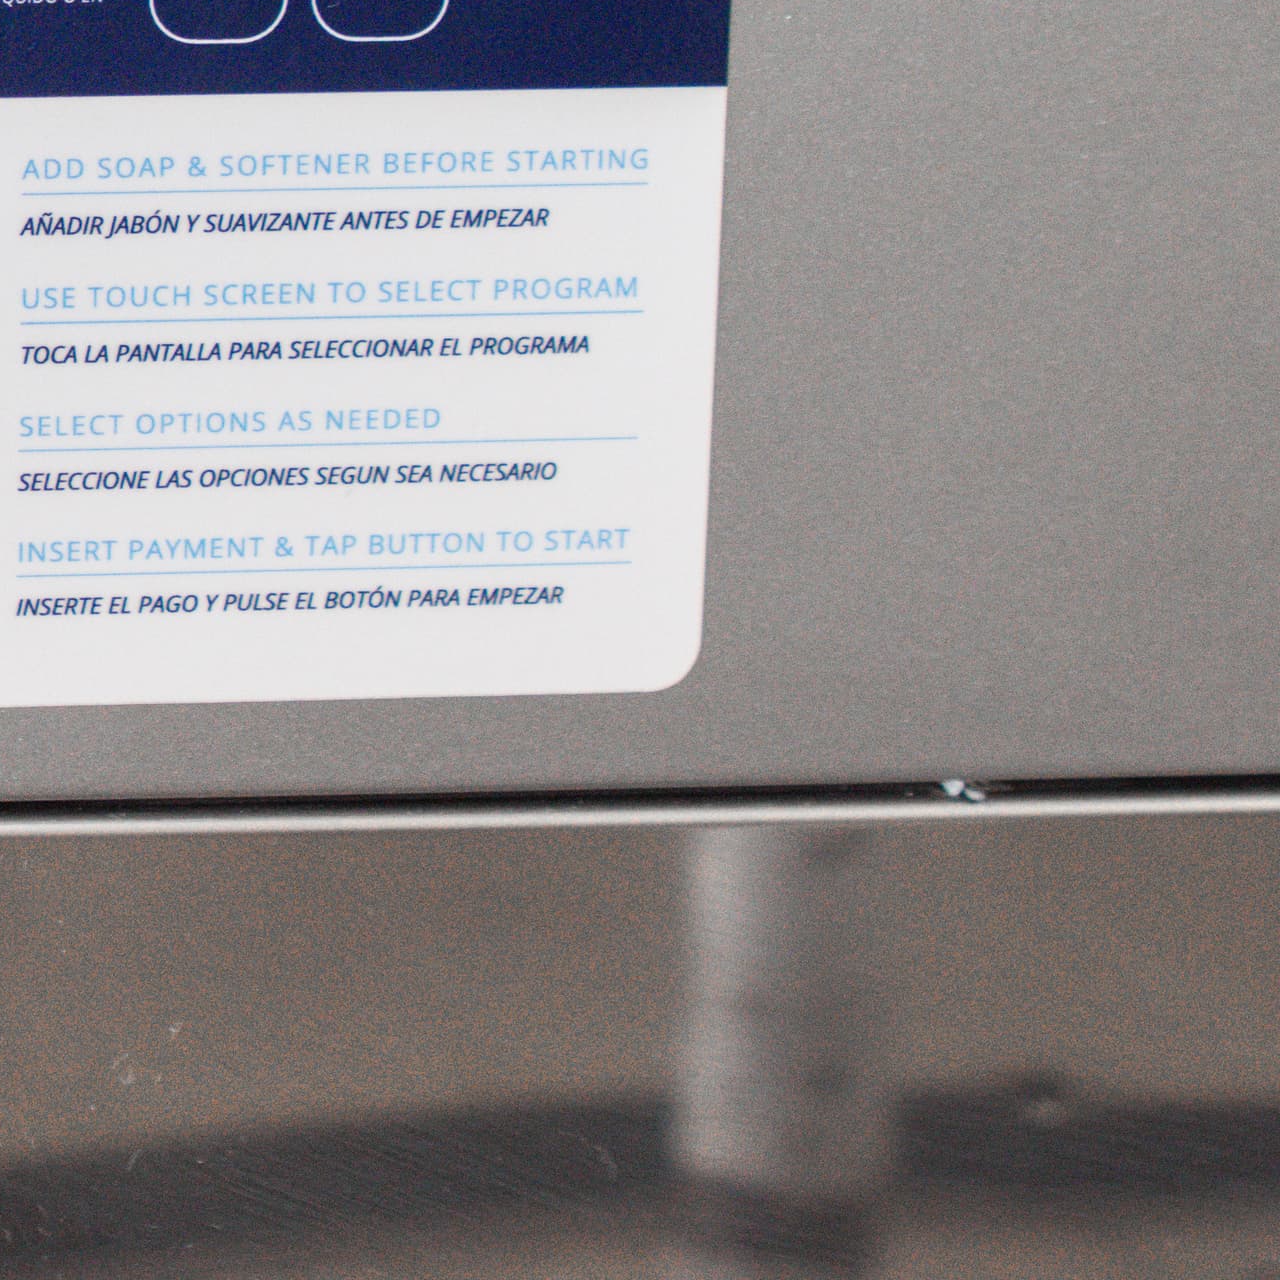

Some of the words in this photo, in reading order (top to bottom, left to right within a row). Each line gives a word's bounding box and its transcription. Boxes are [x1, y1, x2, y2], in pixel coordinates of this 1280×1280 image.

[22, 158, 84, 180] ADD
[98, 156, 175, 179] SOAP
[188, 156, 206, 177] &
[220, 153, 369, 177] SOFTENER
[383, 151, 493, 174] BEFORE
[507, 148, 648, 172] STARTING
[20, 212, 104, 236] AÑADIR
[105, 210, 180, 239] JABÓN
[187, 214, 200, 233] Y
[203, 212, 336, 233] SUAVIZANTE
[340, 211, 409, 230] ANTES
[415, 210, 445, 229] DE
[450, 208, 549, 228] EMPEZAR
[22, 287, 75, 309] USE
[88, 285, 191, 308] TOUCH
[204, 283, 315, 306] SCREEN
[327, 281, 366, 303] TO
[378, 279, 482, 303] SELECT
[494, 276, 637, 300] PROGRAM
[22, 345, 77, 364] TOCA
[84, 345, 108, 363] LA
[116, 343, 221, 362] PANTALLA
[228, 341, 282, 360] PARA
[288, 338, 434, 359] SELECCIONAR
[439, 338, 461, 356] EL
[469, 336, 589, 355] PROGRAMA
[20, 414, 123, 437] SELECT
[136, 411, 266, 435] OPTIONS
[278, 410, 312, 431] AS
[325, 408, 441, 430] NEEDED
[18, 471, 150, 492] SELECCIONE
[155, 470, 193, 489] LAS
[199, 467, 309, 488] OPCIONES
[315, 466, 390, 485] SEGUN
[395, 465, 432, 483] SEA
[439, 462, 557, 482] NECESARIO
[19, 540, 117, 562] INSERT
[129, 536, 264, 560] PAYMENT
[274, 536, 293, 557] &
[305, 534, 357, 556] TAP
[368, 532, 484, 555] BUTTON
[496, 531, 533, 552] TO
[544, 528, 630, 551] START
[16, 597, 103, 616] INSERTE
[108, 596, 130, 614] EL
[138, 594, 198, 613] PAGO
[206, 594, 219, 612] Y
[223, 592, 289, 611] PULSE
[294, 592, 316, 610] EL
[324, 586, 402, 609] BOTÓN
[407, 589, 460, 607] PARA
[467, 586, 564, 606] EMPEZAR
